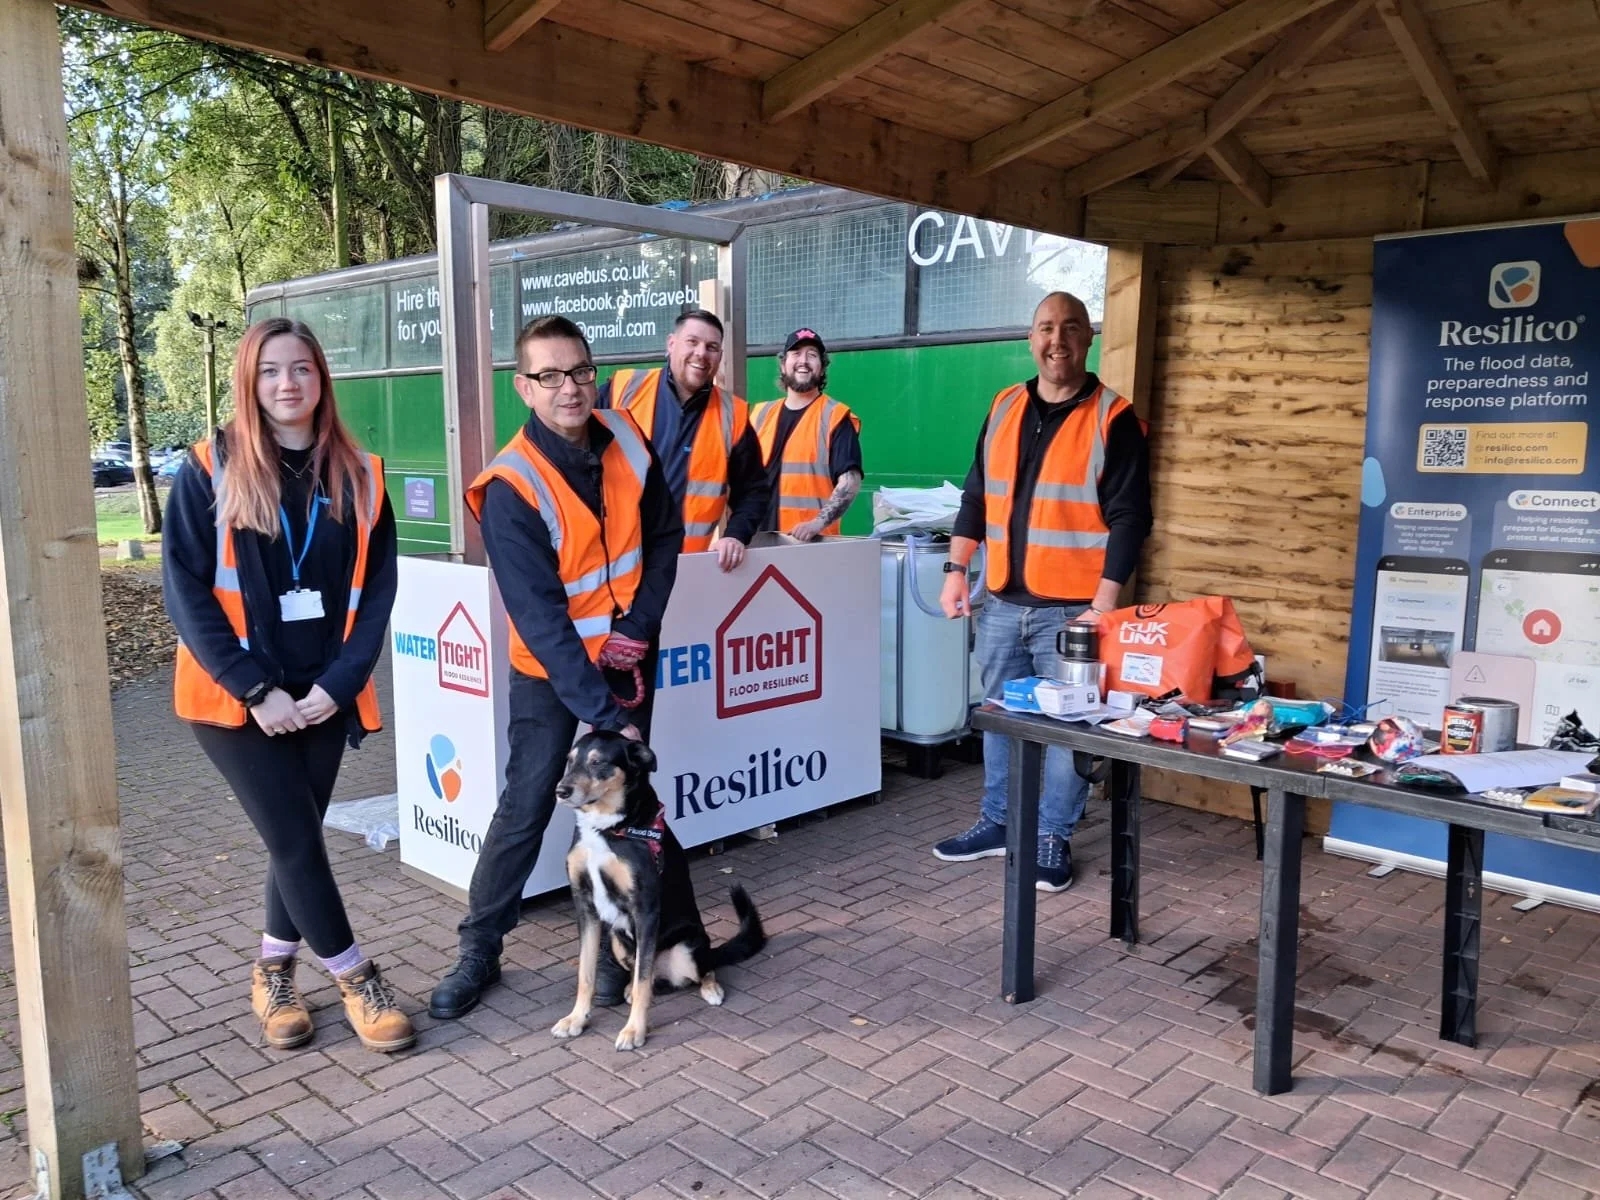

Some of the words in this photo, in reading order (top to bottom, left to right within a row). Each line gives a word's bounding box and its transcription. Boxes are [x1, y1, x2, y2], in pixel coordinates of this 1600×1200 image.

[521, 260, 650, 291] www.cavebus.co.uk
[396, 289, 424, 312] Hire
[427, 286, 441, 308] th
[521, 285, 701, 316] www.facebook.com/cavebu
[397, 319, 417, 341] for
[575, 320, 656, 344] @gmail.com
[1443, 357, 1475, 371] The
[1480, 355, 1525, 370] flood
[1530, 353, 1574, 369] data,
[1427, 374, 1548, 394] preparedness
[1553, 371, 1589, 387] and
[1425, 395, 1505, 411] response
[1510, 392, 1588, 410] platform
[1476, 431, 1497, 439] Find
[1499, 431, 1516, 439] out
[1518, 431, 1543, 439] more
[1485, 443, 1548, 452] resilico.com
[1484, 456, 1578, 466] info@resilico.com
[1407, 506, 1462, 518] Enterprise
[1531, 494, 1596, 508] Connect
[394, 631, 437, 662] WATER
[442, 640, 482, 671] TIGHT
[655, 643, 712, 690] TER
[727, 627, 811, 676] TIGHT
[729, 683, 760, 698] FLOOD
[763, 673, 810, 691] RESILIENCE
[673, 747, 827, 821] Resilico
[413, 803, 482, 855] Resilico
[647, 830, 662, 839] Dog
